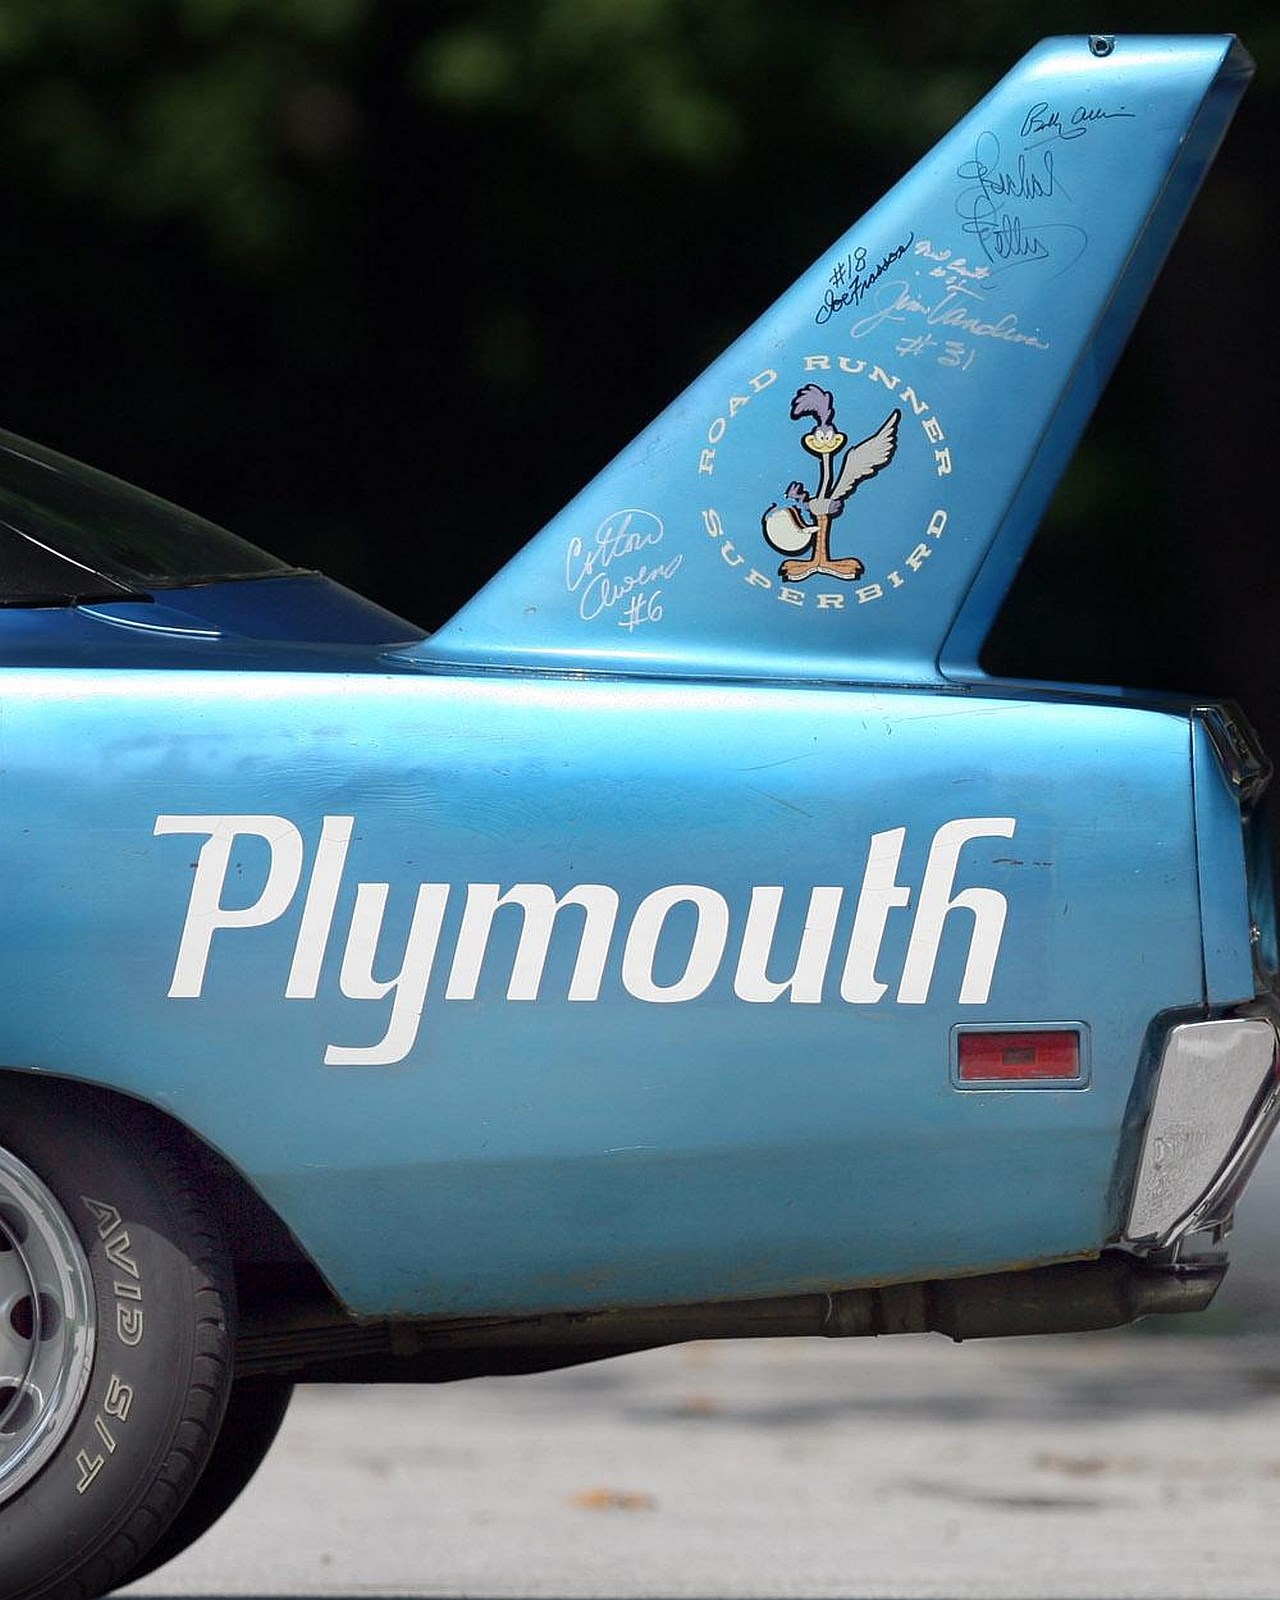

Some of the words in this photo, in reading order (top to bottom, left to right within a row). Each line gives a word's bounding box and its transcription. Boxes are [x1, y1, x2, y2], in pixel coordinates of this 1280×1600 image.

[828, 246, 868, 289] #18
[698, 368, 779, 476] ROAD
[802, 353, 954, 478] RUNNER
[617, 590, 664, 632] #6
[700, 508, 949, 611] SUPERBIRD
[153, 815, 1017, 1066] Plymouth
[80, 1195, 145, 1348] AVID
